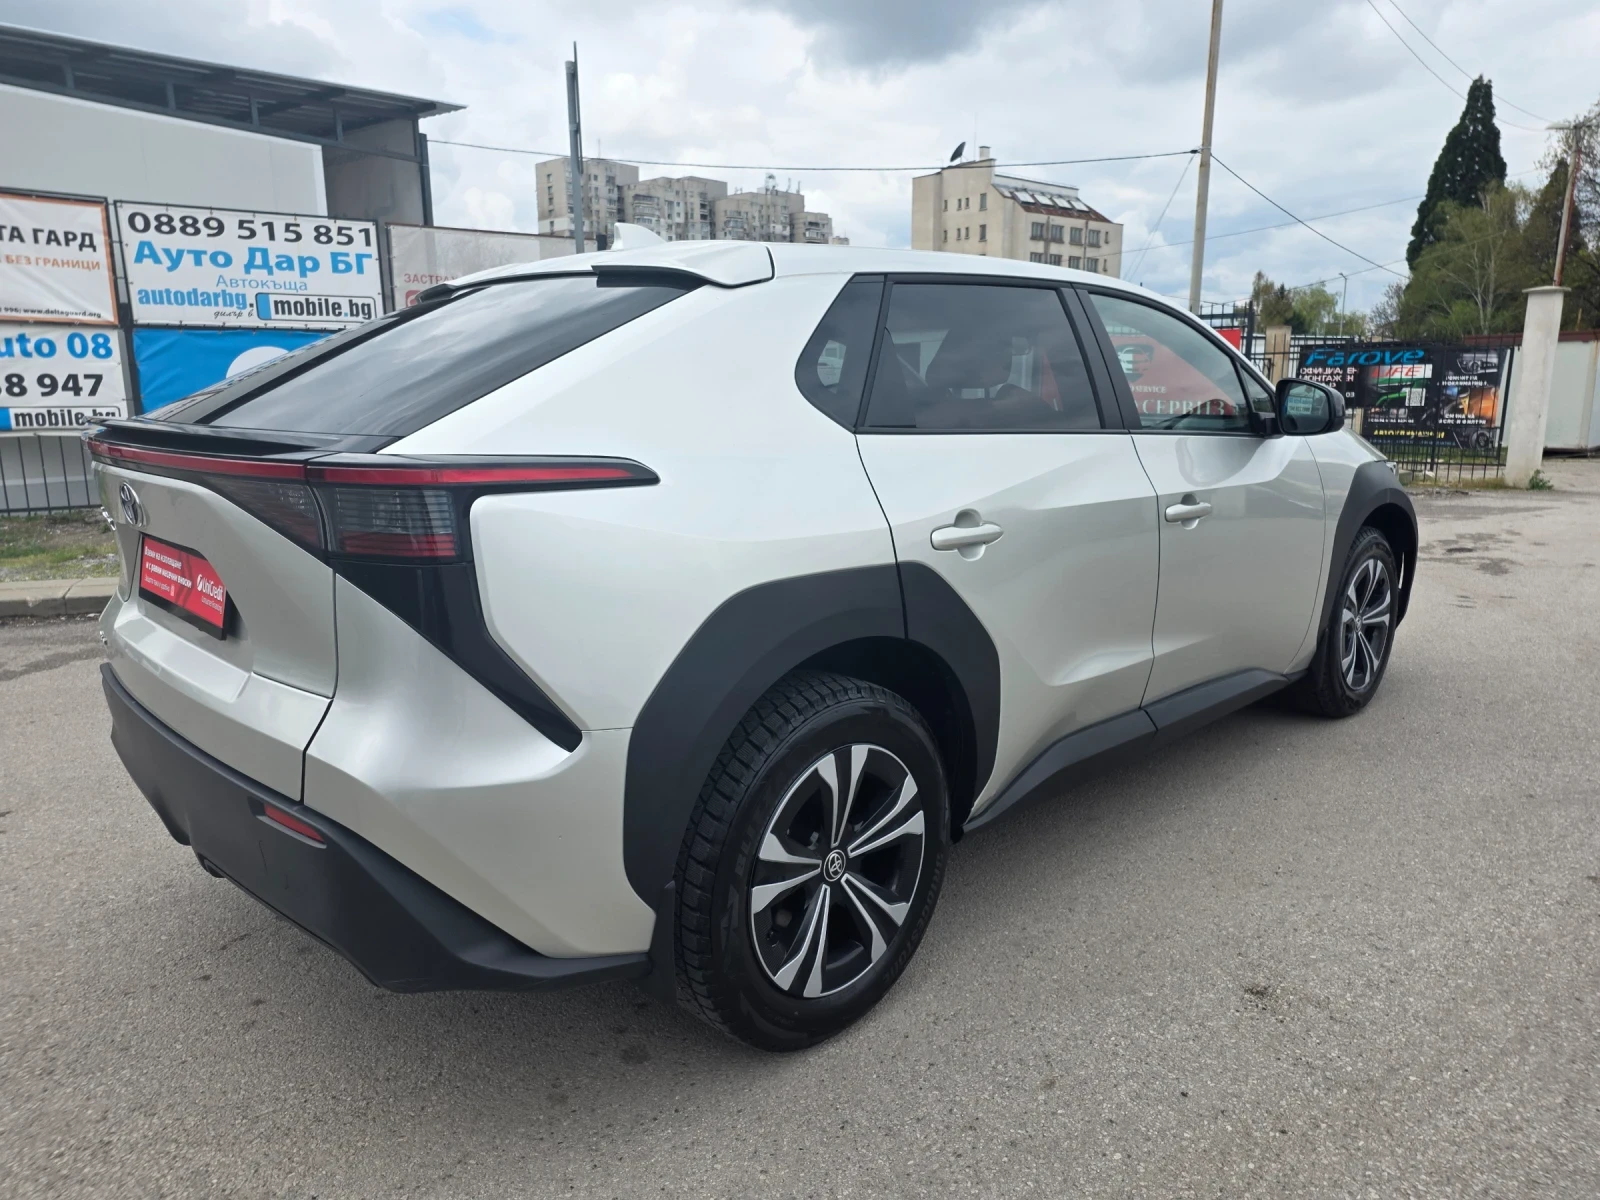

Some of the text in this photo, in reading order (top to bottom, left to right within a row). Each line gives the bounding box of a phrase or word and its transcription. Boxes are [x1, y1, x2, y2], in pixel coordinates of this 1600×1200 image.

[128, 211, 372, 247] 0889 515 851
[32, 227, 97, 253] ГАРД
[5, 253, 101, 271] БЕЗ ГРАНИЦИ
[134, 240, 373, 279] Ауто Дар БГ
[216, 274, 308, 293] Автокъща
[23, 307, 102, 318] www.deltaguard.org
[273, 297, 373, 320] mobile.bg
[66, 332, 113, 359] 08
[1305, 348, 1425, 366] Farove
[1371, 366, 1423, 378] LIFE
[0, 373, 104, 397] 8 947
[14, 408, 116, 427] mobile
[1135, 399, 1224, 415] СЕРВИЗ
[202, 577, 223, 602] UniCredit
